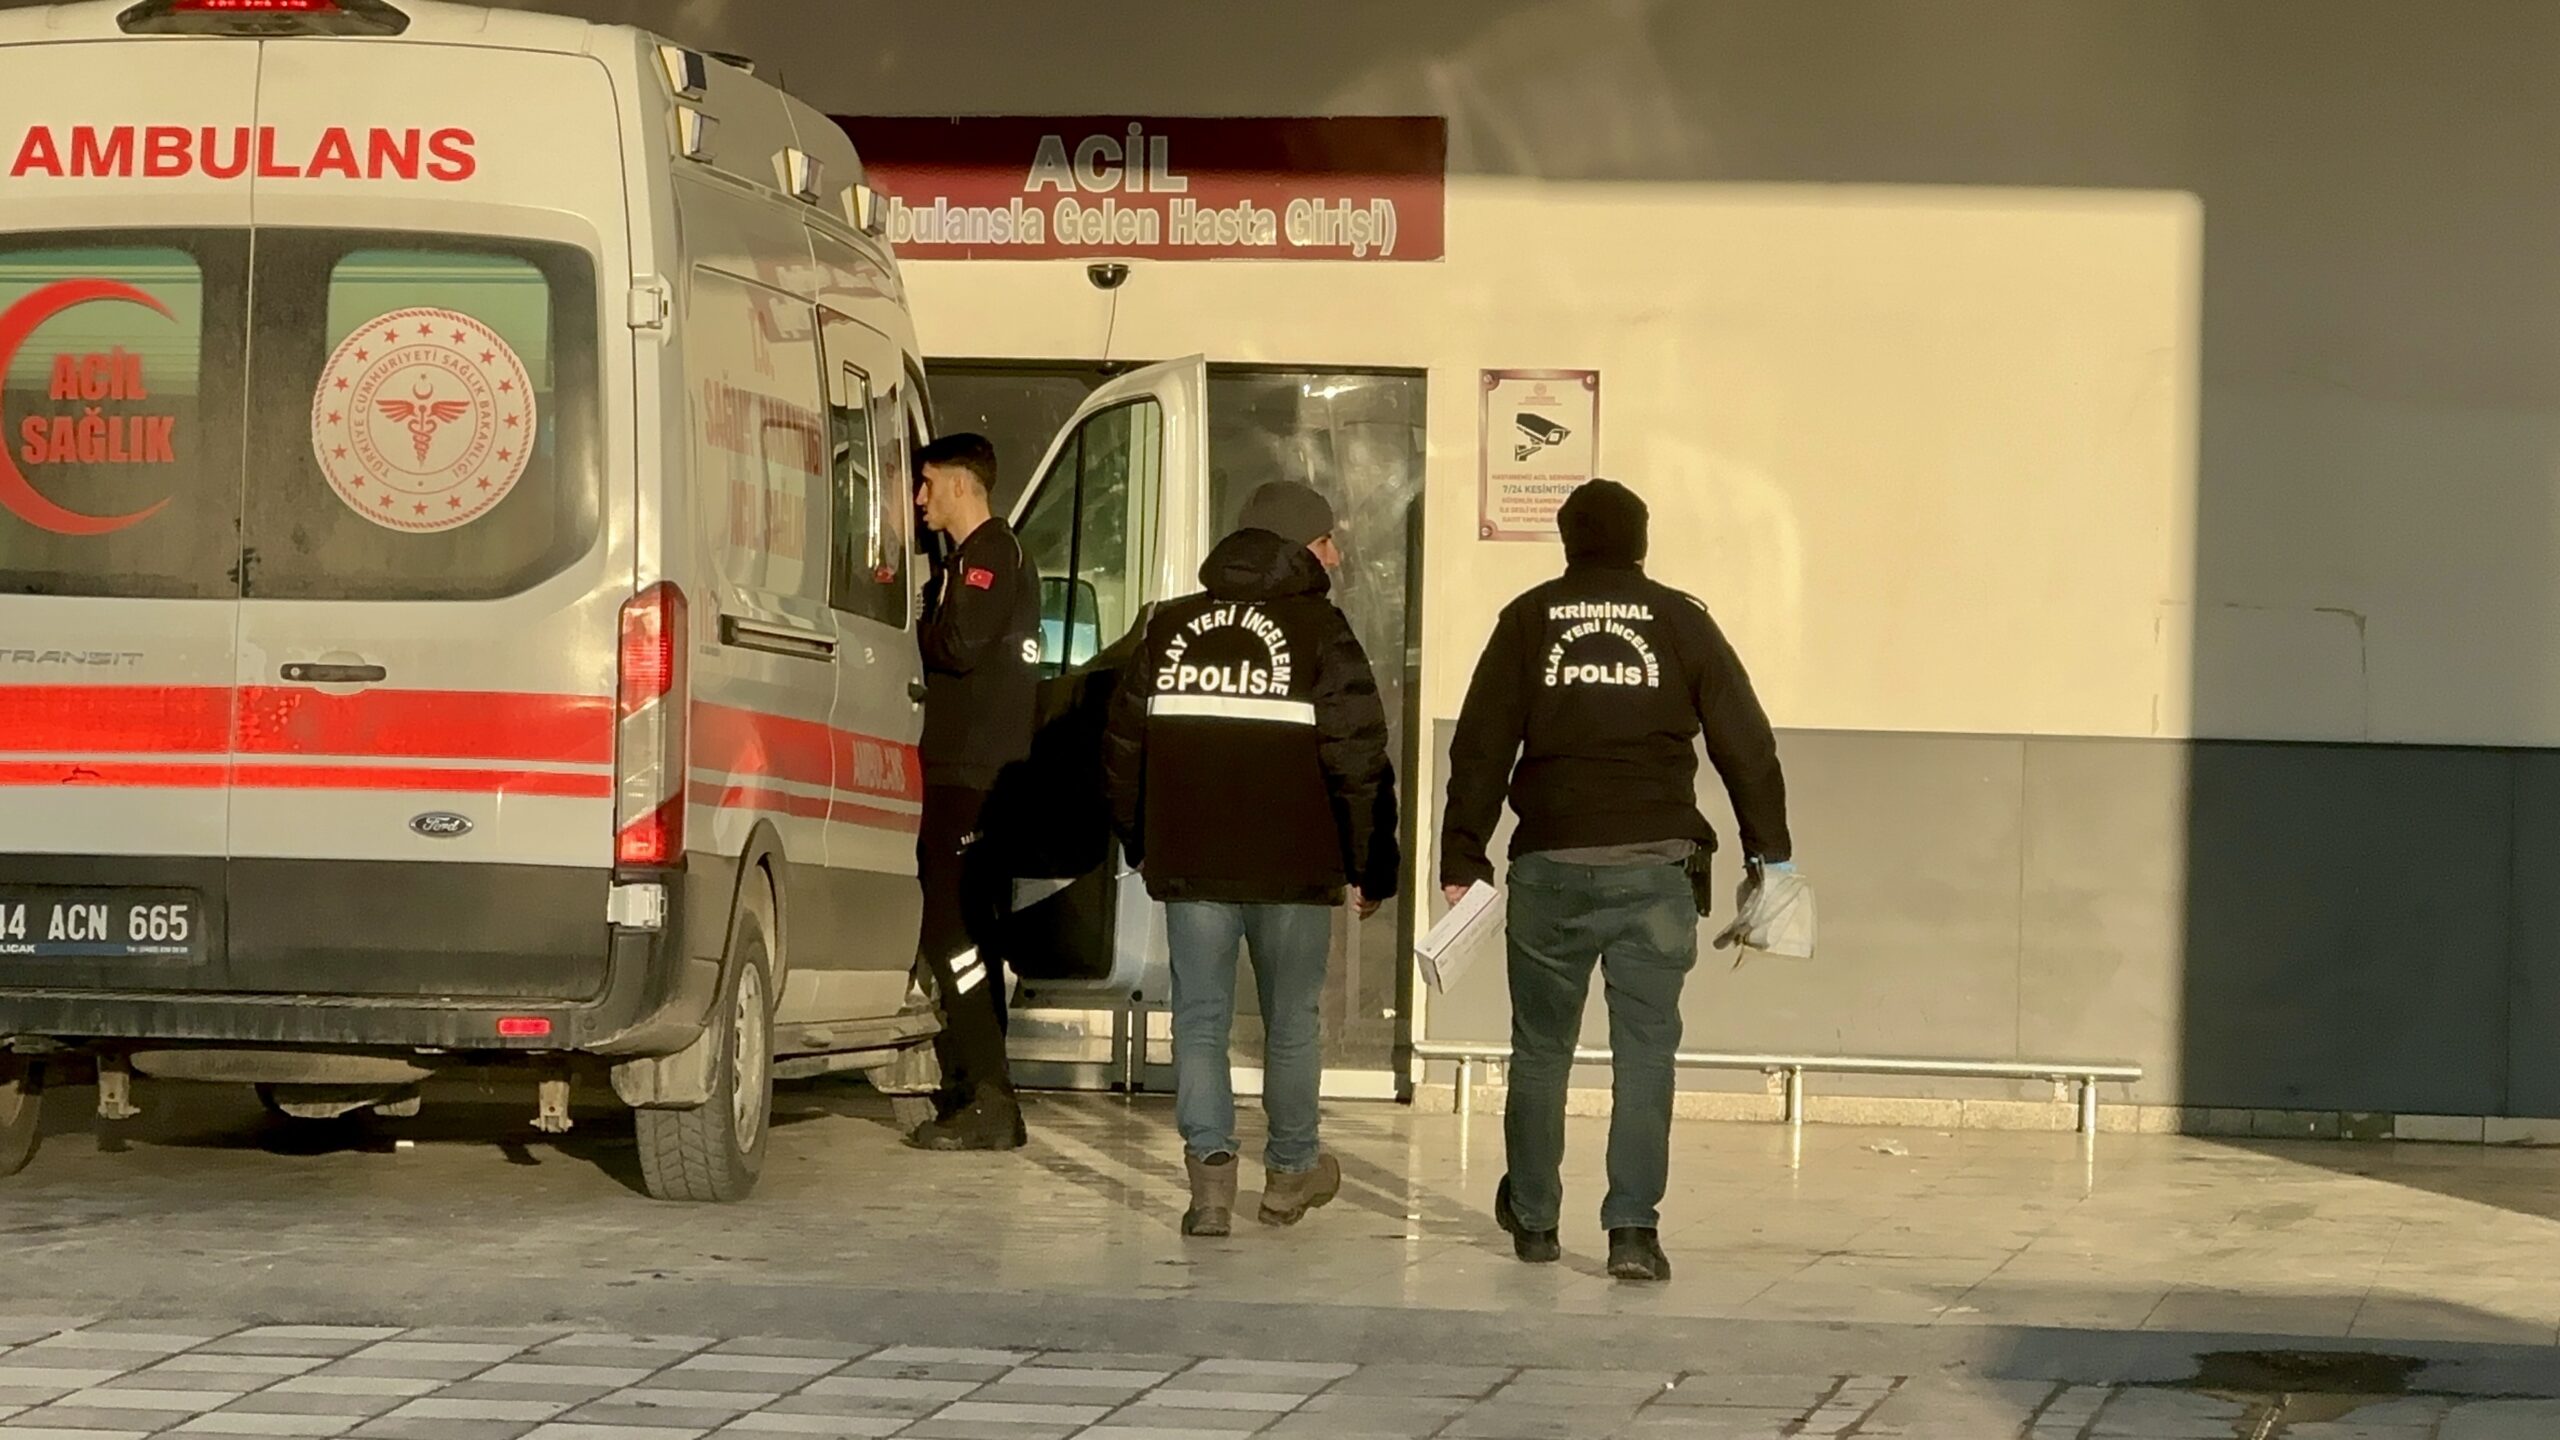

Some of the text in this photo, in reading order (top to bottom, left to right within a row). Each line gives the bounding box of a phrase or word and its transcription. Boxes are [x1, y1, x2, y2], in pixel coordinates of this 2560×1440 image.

[9, 125, 476, 182] AMBULANS
[1023, 121, 1188, 193] ACİL
[886, 196, 1397, 257] bulansla Gelen Hasta Girişi)
[50, 344, 148, 400] ACİL
[21, 406, 175, 465] SAĞLIK
[353, 350, 491, 478] TÜRKİYE CUMHURİYETİ SAĞLIK BAKANLIĞI
[1502, 484, 1522, 494] 7/24
[1548, 601, 1654, 620] KRİMİNAL
[1156, 604, 1292, 697] OLAY YERİ İNCELEME
[1177, 660, 1269, 695] POLİS
[1545, 618, 1660, 688] OLAY YERİ İNCELEME
[1563, 661, 1642, 686] POLİS
[422, 816, 461, 832] Ford
[48, 904, 108, 941] ACN
[128, 905, 188, 941] 665
